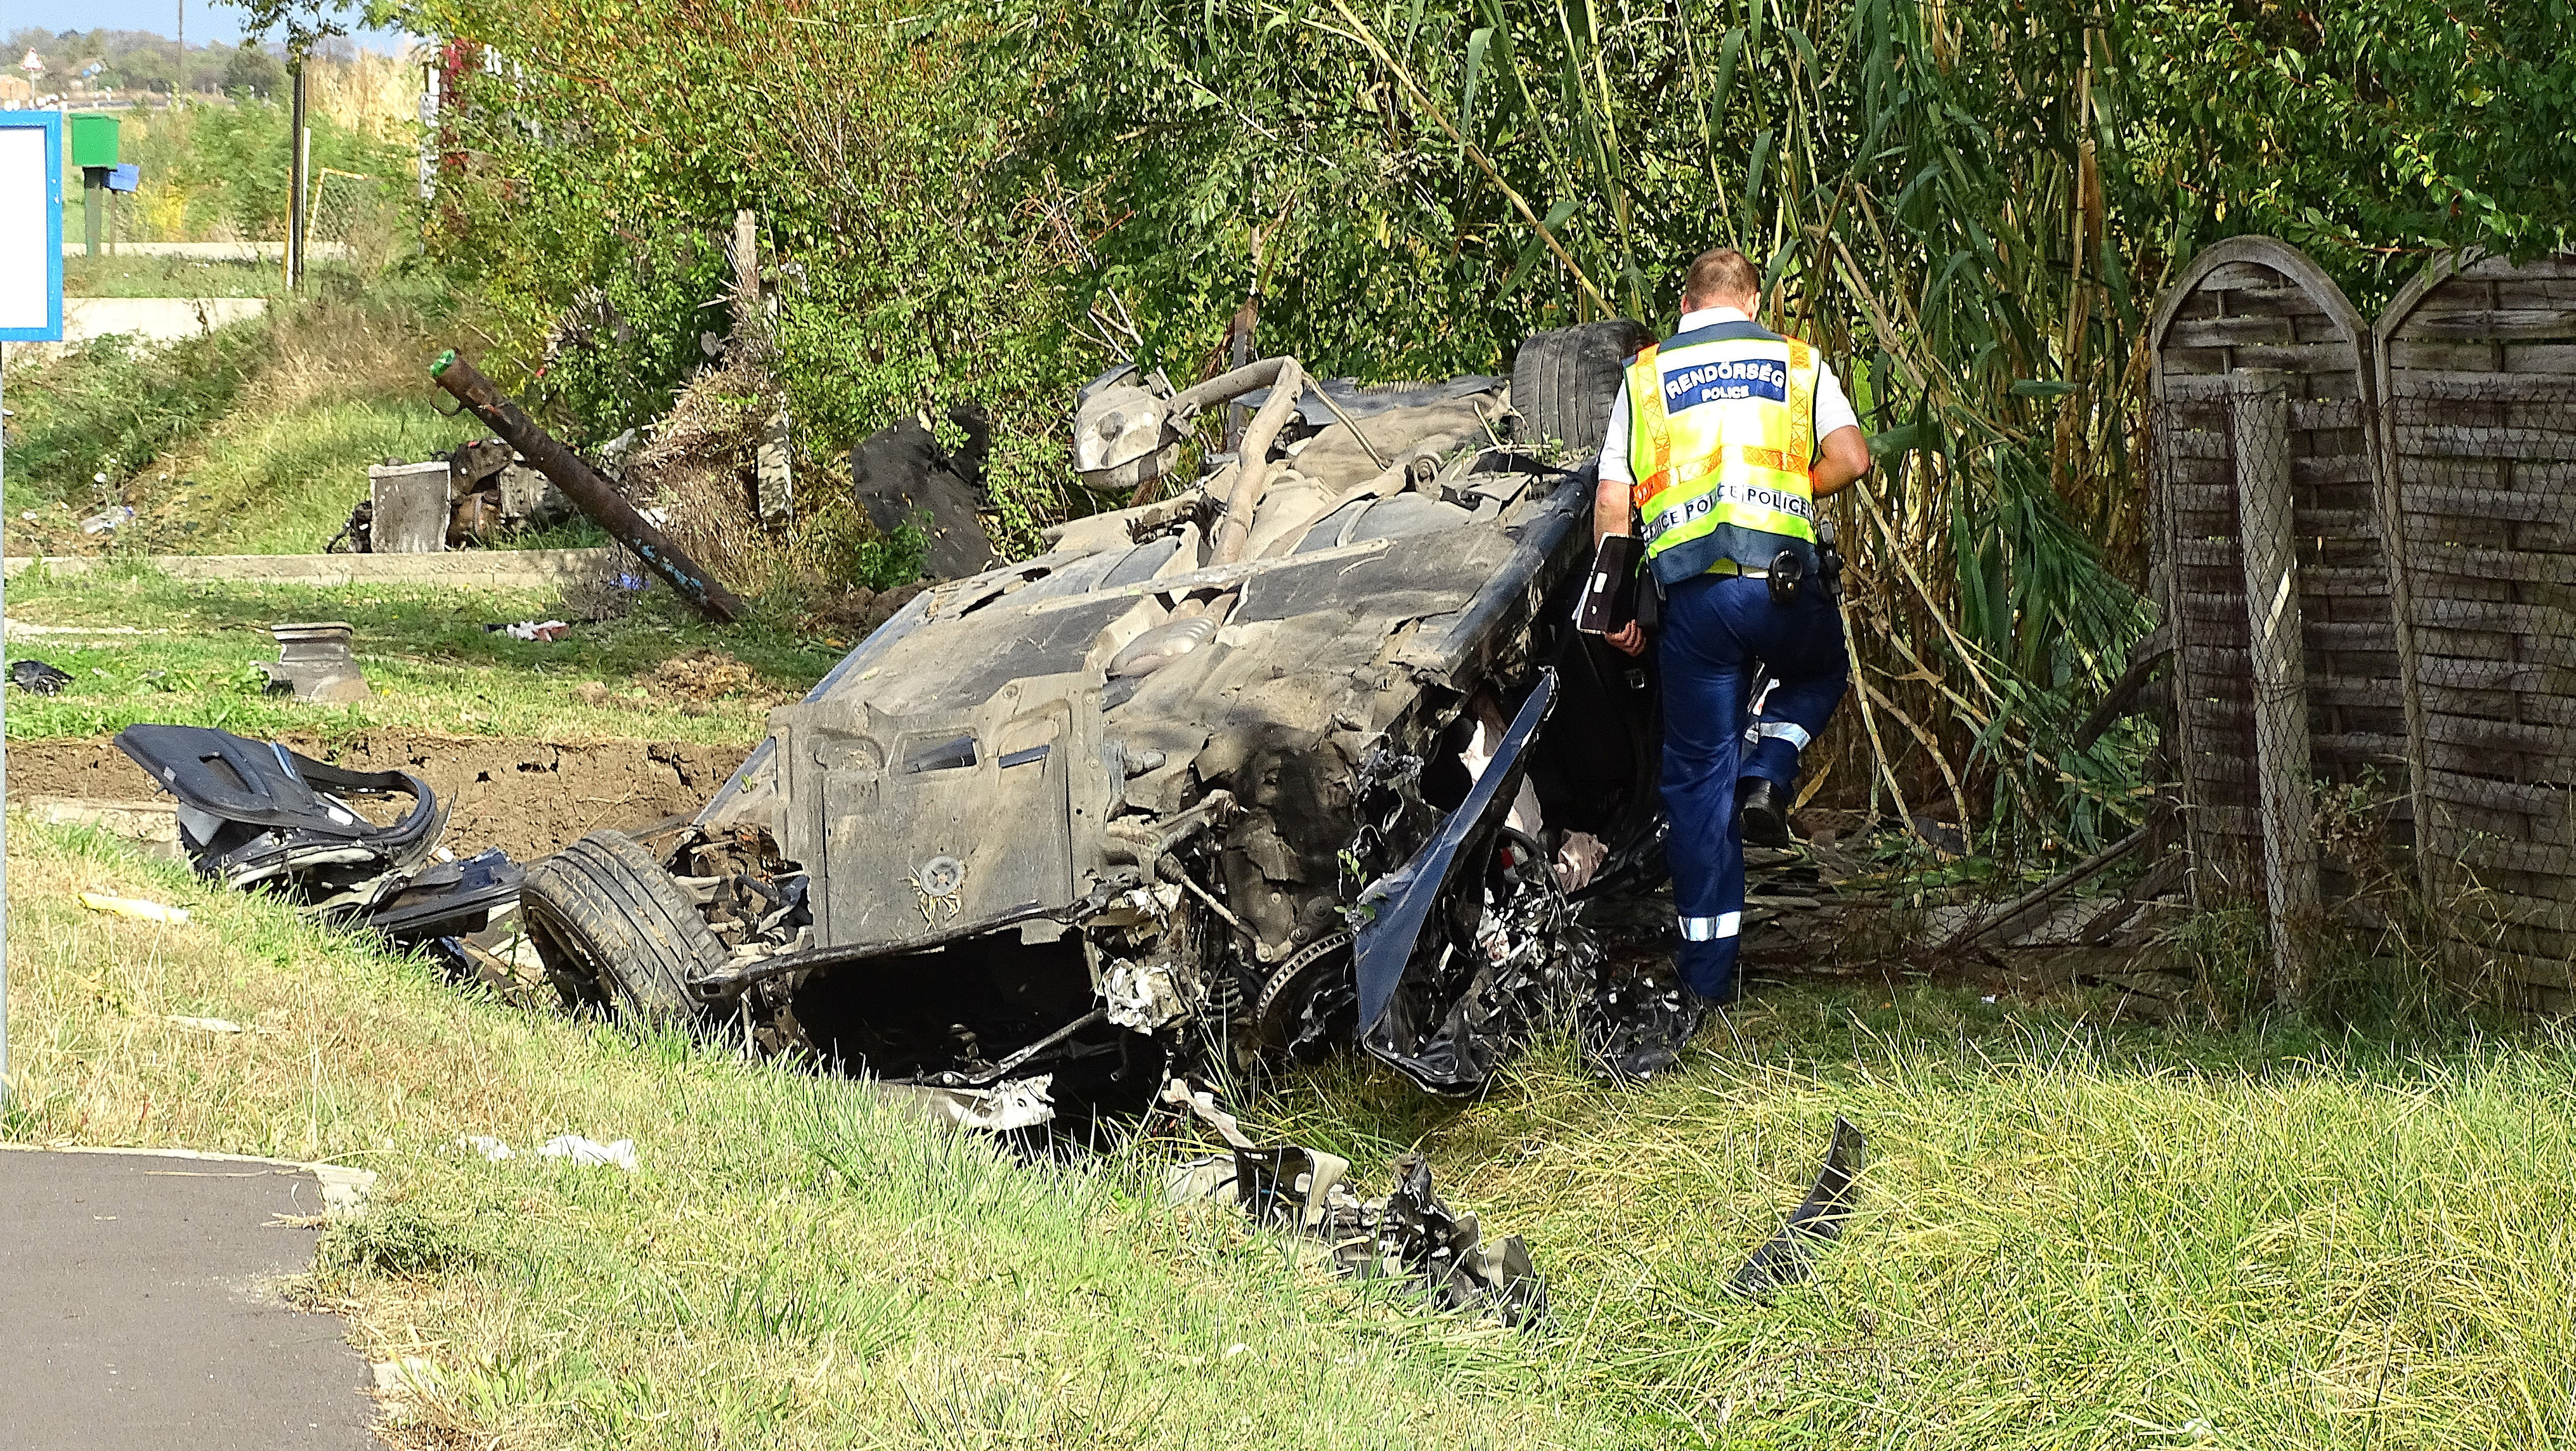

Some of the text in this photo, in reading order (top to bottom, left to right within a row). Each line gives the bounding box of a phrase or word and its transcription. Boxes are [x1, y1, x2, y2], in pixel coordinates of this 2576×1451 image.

[1665, 362, 1785, 399] RENDŐRSÉG
[1701, 385, 1749, 402] POLICE
[1747, 488, 1806, 516] POLICE
